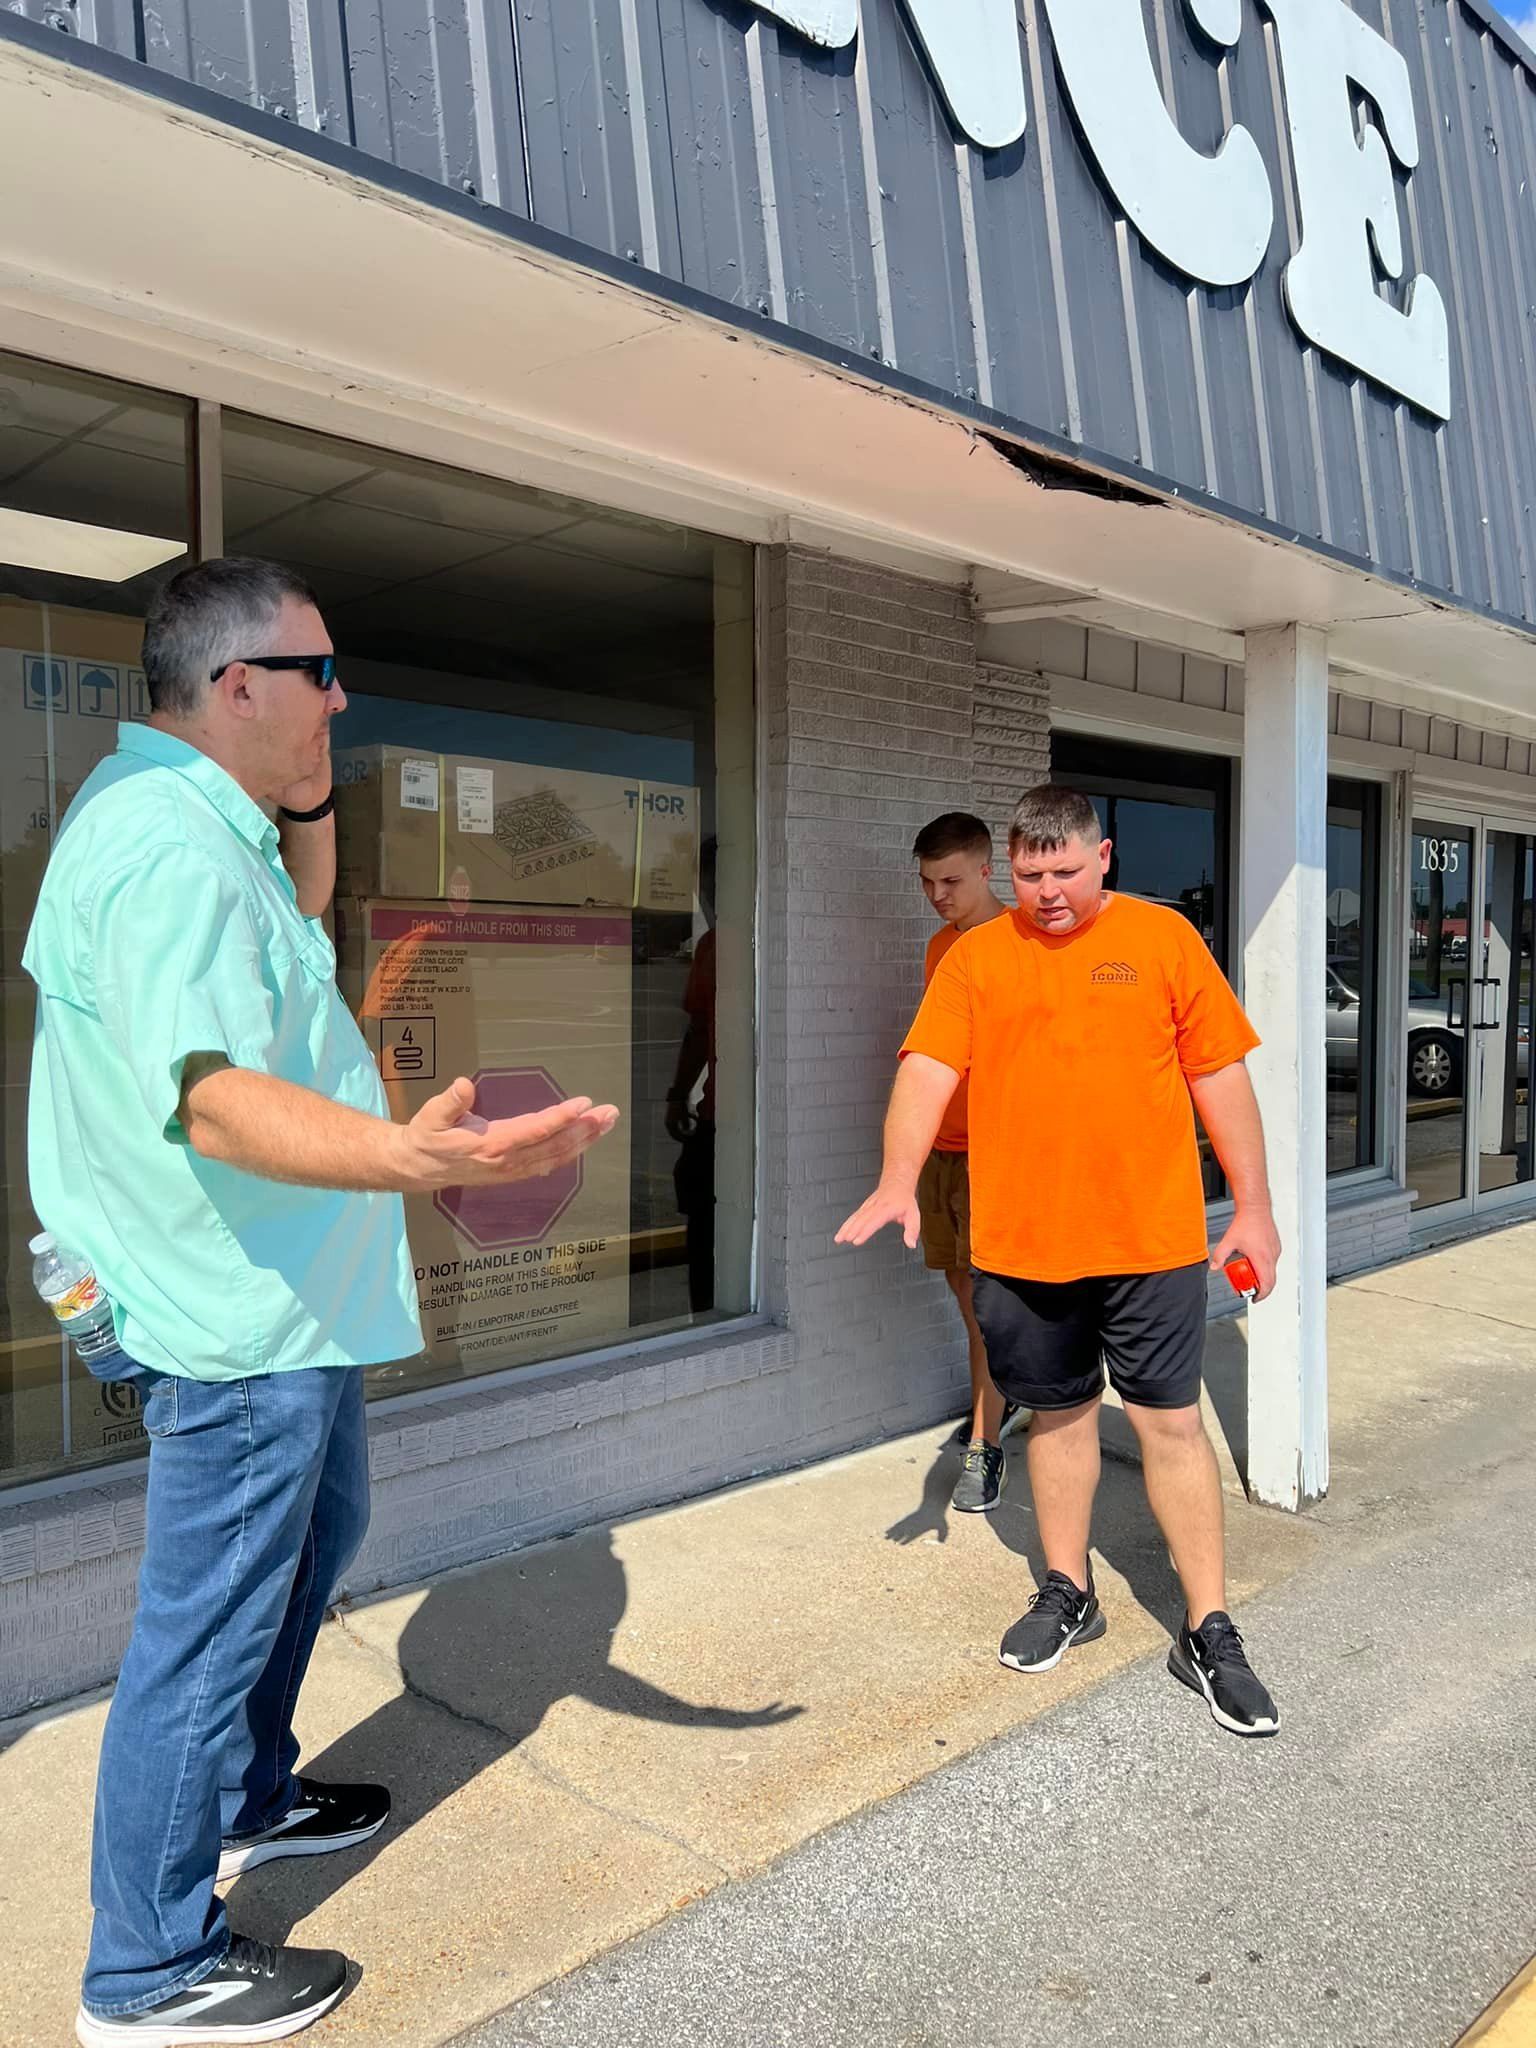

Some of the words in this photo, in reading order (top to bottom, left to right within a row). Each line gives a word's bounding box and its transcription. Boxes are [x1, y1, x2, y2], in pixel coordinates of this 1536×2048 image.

[624, 790, 685, 815] THOR
[1420, 838, 1459, 873] 1835
[411, 919, 427, 933] DO
[431, 920, 451, 934] NOT
[456, 921, 498, 935] HANDLE
[500, 922, 528, 937] FROM
[531, 923, 552, 937] THIS
[553, 924, 577, 938] SIDE
[1091, 973, 1138, 982] ICONIC
[401, 1025, 414, 1044] 4
[414, 1267, 425, 1281] O
[429, 1261, 460, 1278] NOT
[463, 1252, 519, 1273] HANDLE
[523, 1249, 542, 1263] ON
[547, 1244, 575, 1259] THIS
[577, 1239, 606, 1254] SIDE
[431, 1277, 483, 1295] HANDLING
[485, 1273, 514, 1286] FROM
[516, 1268, 538, 1281] THIS
[540, 1265, 561, 1278] SIDE
[563, 1261, 583, 1274] MAY
[457, 1292, 468, 1304] IN
[470, 1284, 513, 1301] DAMAGE
[515, 1282, 528, 1293] TO
[530, 1278, 548, 1291] THE
[478, 1311, 525, 1328] EMPOTRAR
